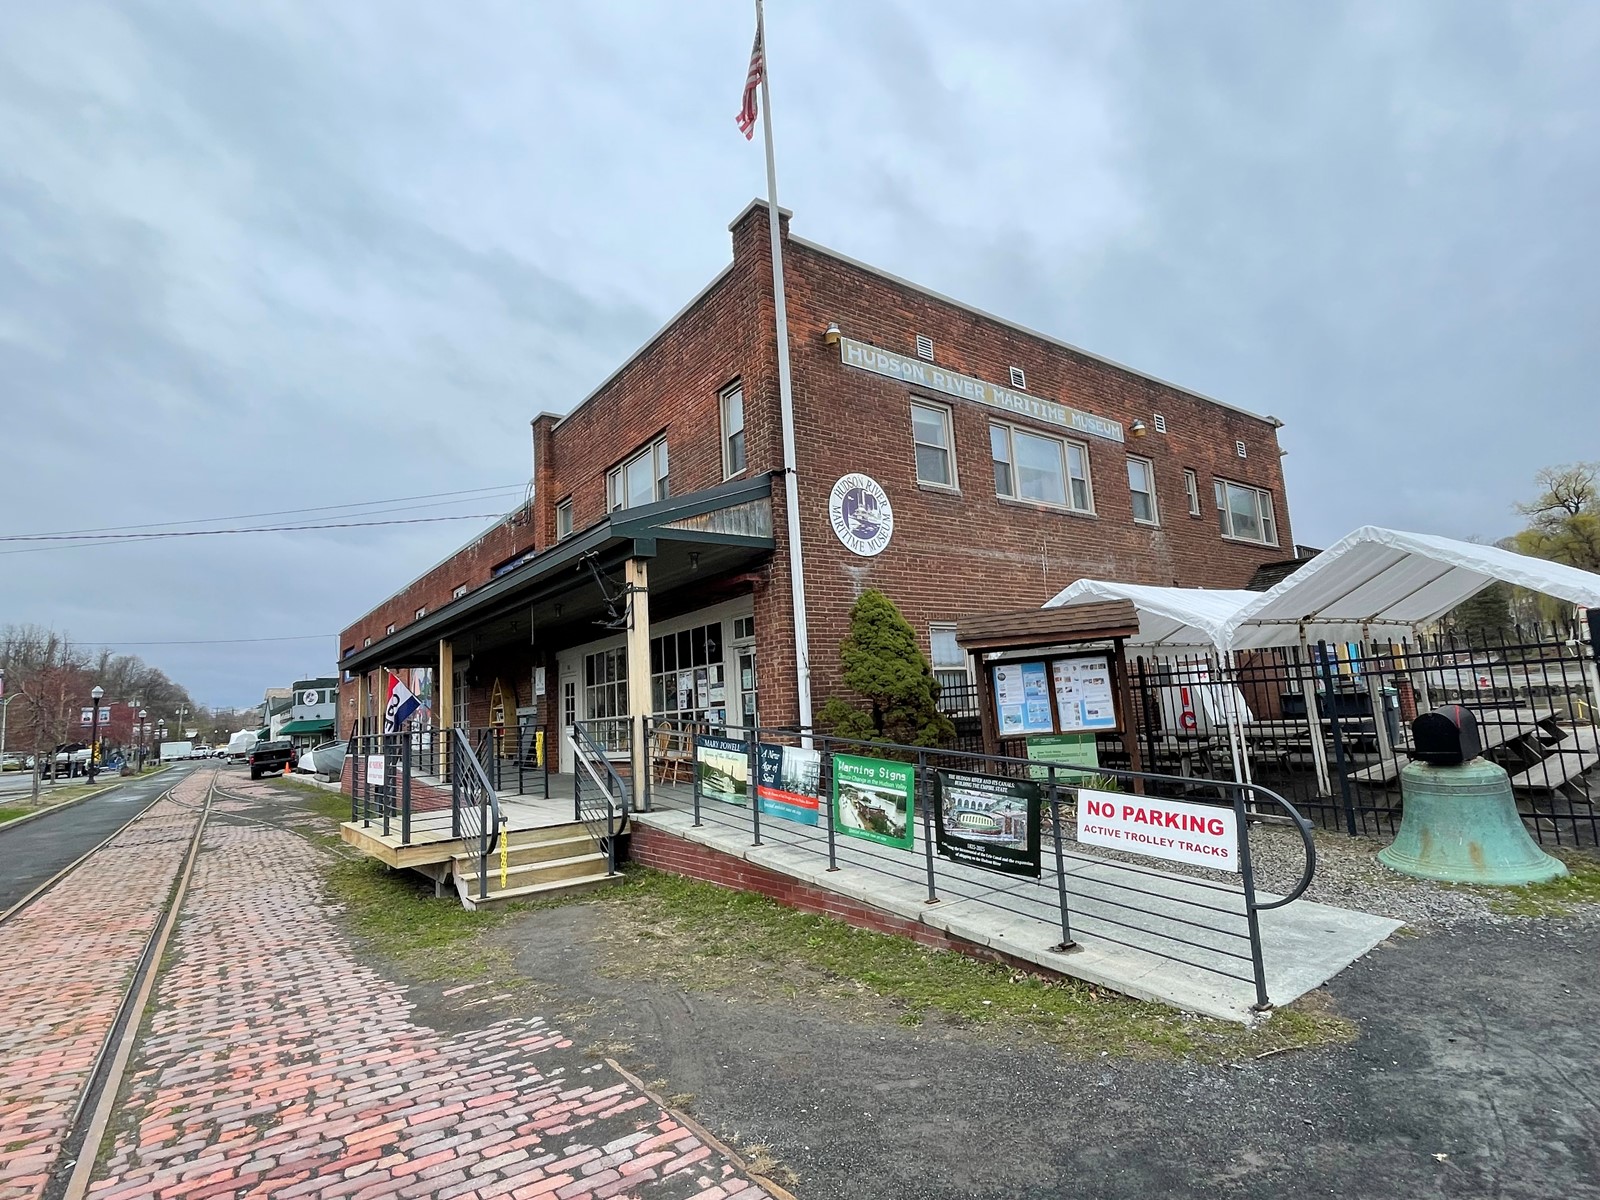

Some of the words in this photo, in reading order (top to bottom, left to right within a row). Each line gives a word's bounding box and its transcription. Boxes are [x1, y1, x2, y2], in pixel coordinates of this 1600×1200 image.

[847, 344, 925, 381] HUDSON
[931, 371, 985, 399] RIVER
[992, 388, 1067, 422] MARITIME
[1071, 412, 1121, 438] MUSEUM
[833, 476, 864, 500] HUDSON
[865, 480, 888, 508] RIVER
[832, 505, 865, 552] MARITIME
[867, 513, 891, 552] MUSEUM
[704, 739, 719, 749] MARY
[719, 741, 741, 752] POWELL
[761, 749, 767, 758] A
[767, 750, 780, 760] New
[761, 761, 772, 772] Age
[772, 763, 779, 773] of
[838, 760, 875, 777] Warning
[879, 767, 906, 781] Signs
[762, 773, 775, 783] Sail
[956, 774, 971, 782] HUDSON
[879, 780, 895, 788] Hudson
[895, 782, 907, 791] Valley
[954, 780, 972, 788] BUILDING
[980, 784, 995, 792] EMPIRE
[1087, 800, 1115, 818] NO
[1122, 805, 1224, 836] PARKING
[1083, 824, 1121, 838] ACTIVE
[1124, 831, 1175, 848] TROLLEY
[1178, 840, 1229, 858] TRACKS
